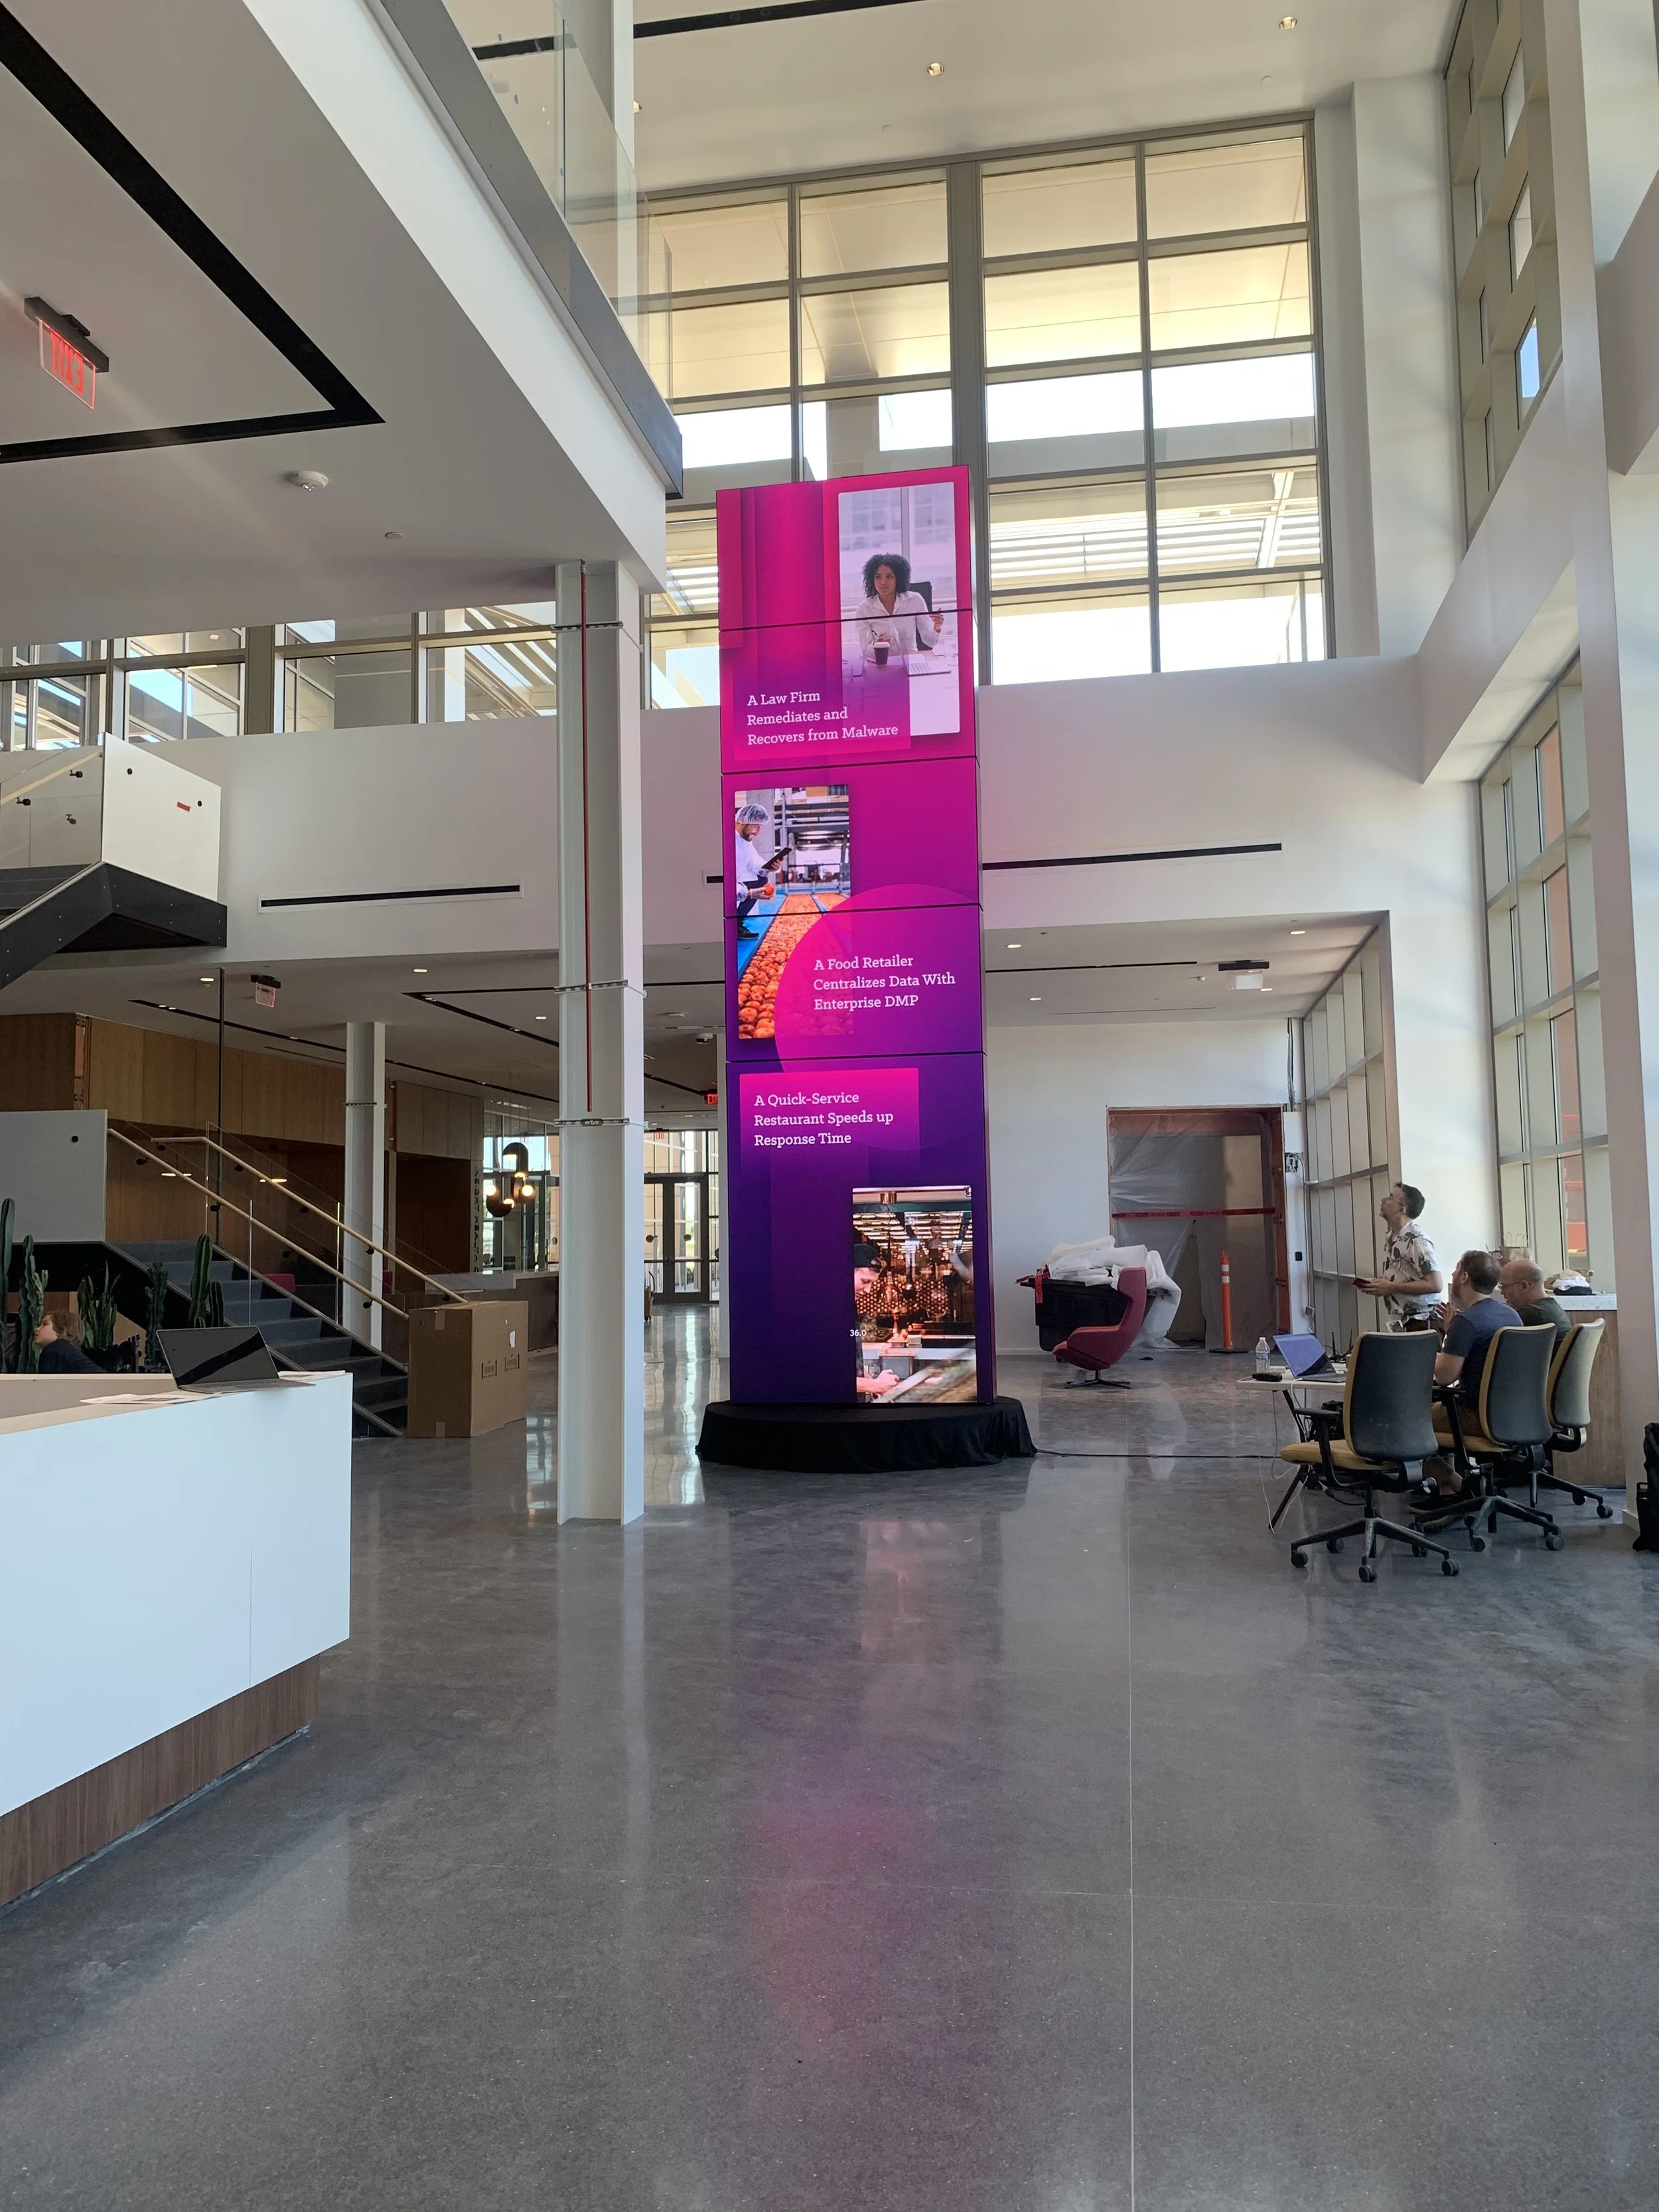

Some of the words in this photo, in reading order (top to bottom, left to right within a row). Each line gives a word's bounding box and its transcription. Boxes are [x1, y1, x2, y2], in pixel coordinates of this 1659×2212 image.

[747, 695, 758, 706] A
[760, 694, 788, 705] Law
[790, 691, 821, 703] Firm
[747, 710, 821, 725] Remediates
[824, 706, 848, 720] and
[747, 733, 805, 745] Recovers
[808, 728, 839, 741] from
[841, 725, 899, 739] Malware
[813, 959, 825, 971] A
[827, 956, 859, 970] Food
[862, 954, 914, 968] Retailer
[813, 976, 886, 990] Centralizes
[889, 976, 920, 987] Data
[922, 972, 956, 986] With
[814, 996, 881, 1012] Enterprise
[884, 995, 918, 1007] DMP
[707, 1094, 718, 1104] EXI
[754, 1095, 766, 1106] A
[767, 1092, 859, 1108] Quick-Service
[754, 1114, 825, 1126] Restaurant
[828, 1110, 873, 1127] Speeds
[875, 1113, 894, 1125] up
[754, 1134, 816, 1149] Response
[818, 1132, 851, 1144] Time
